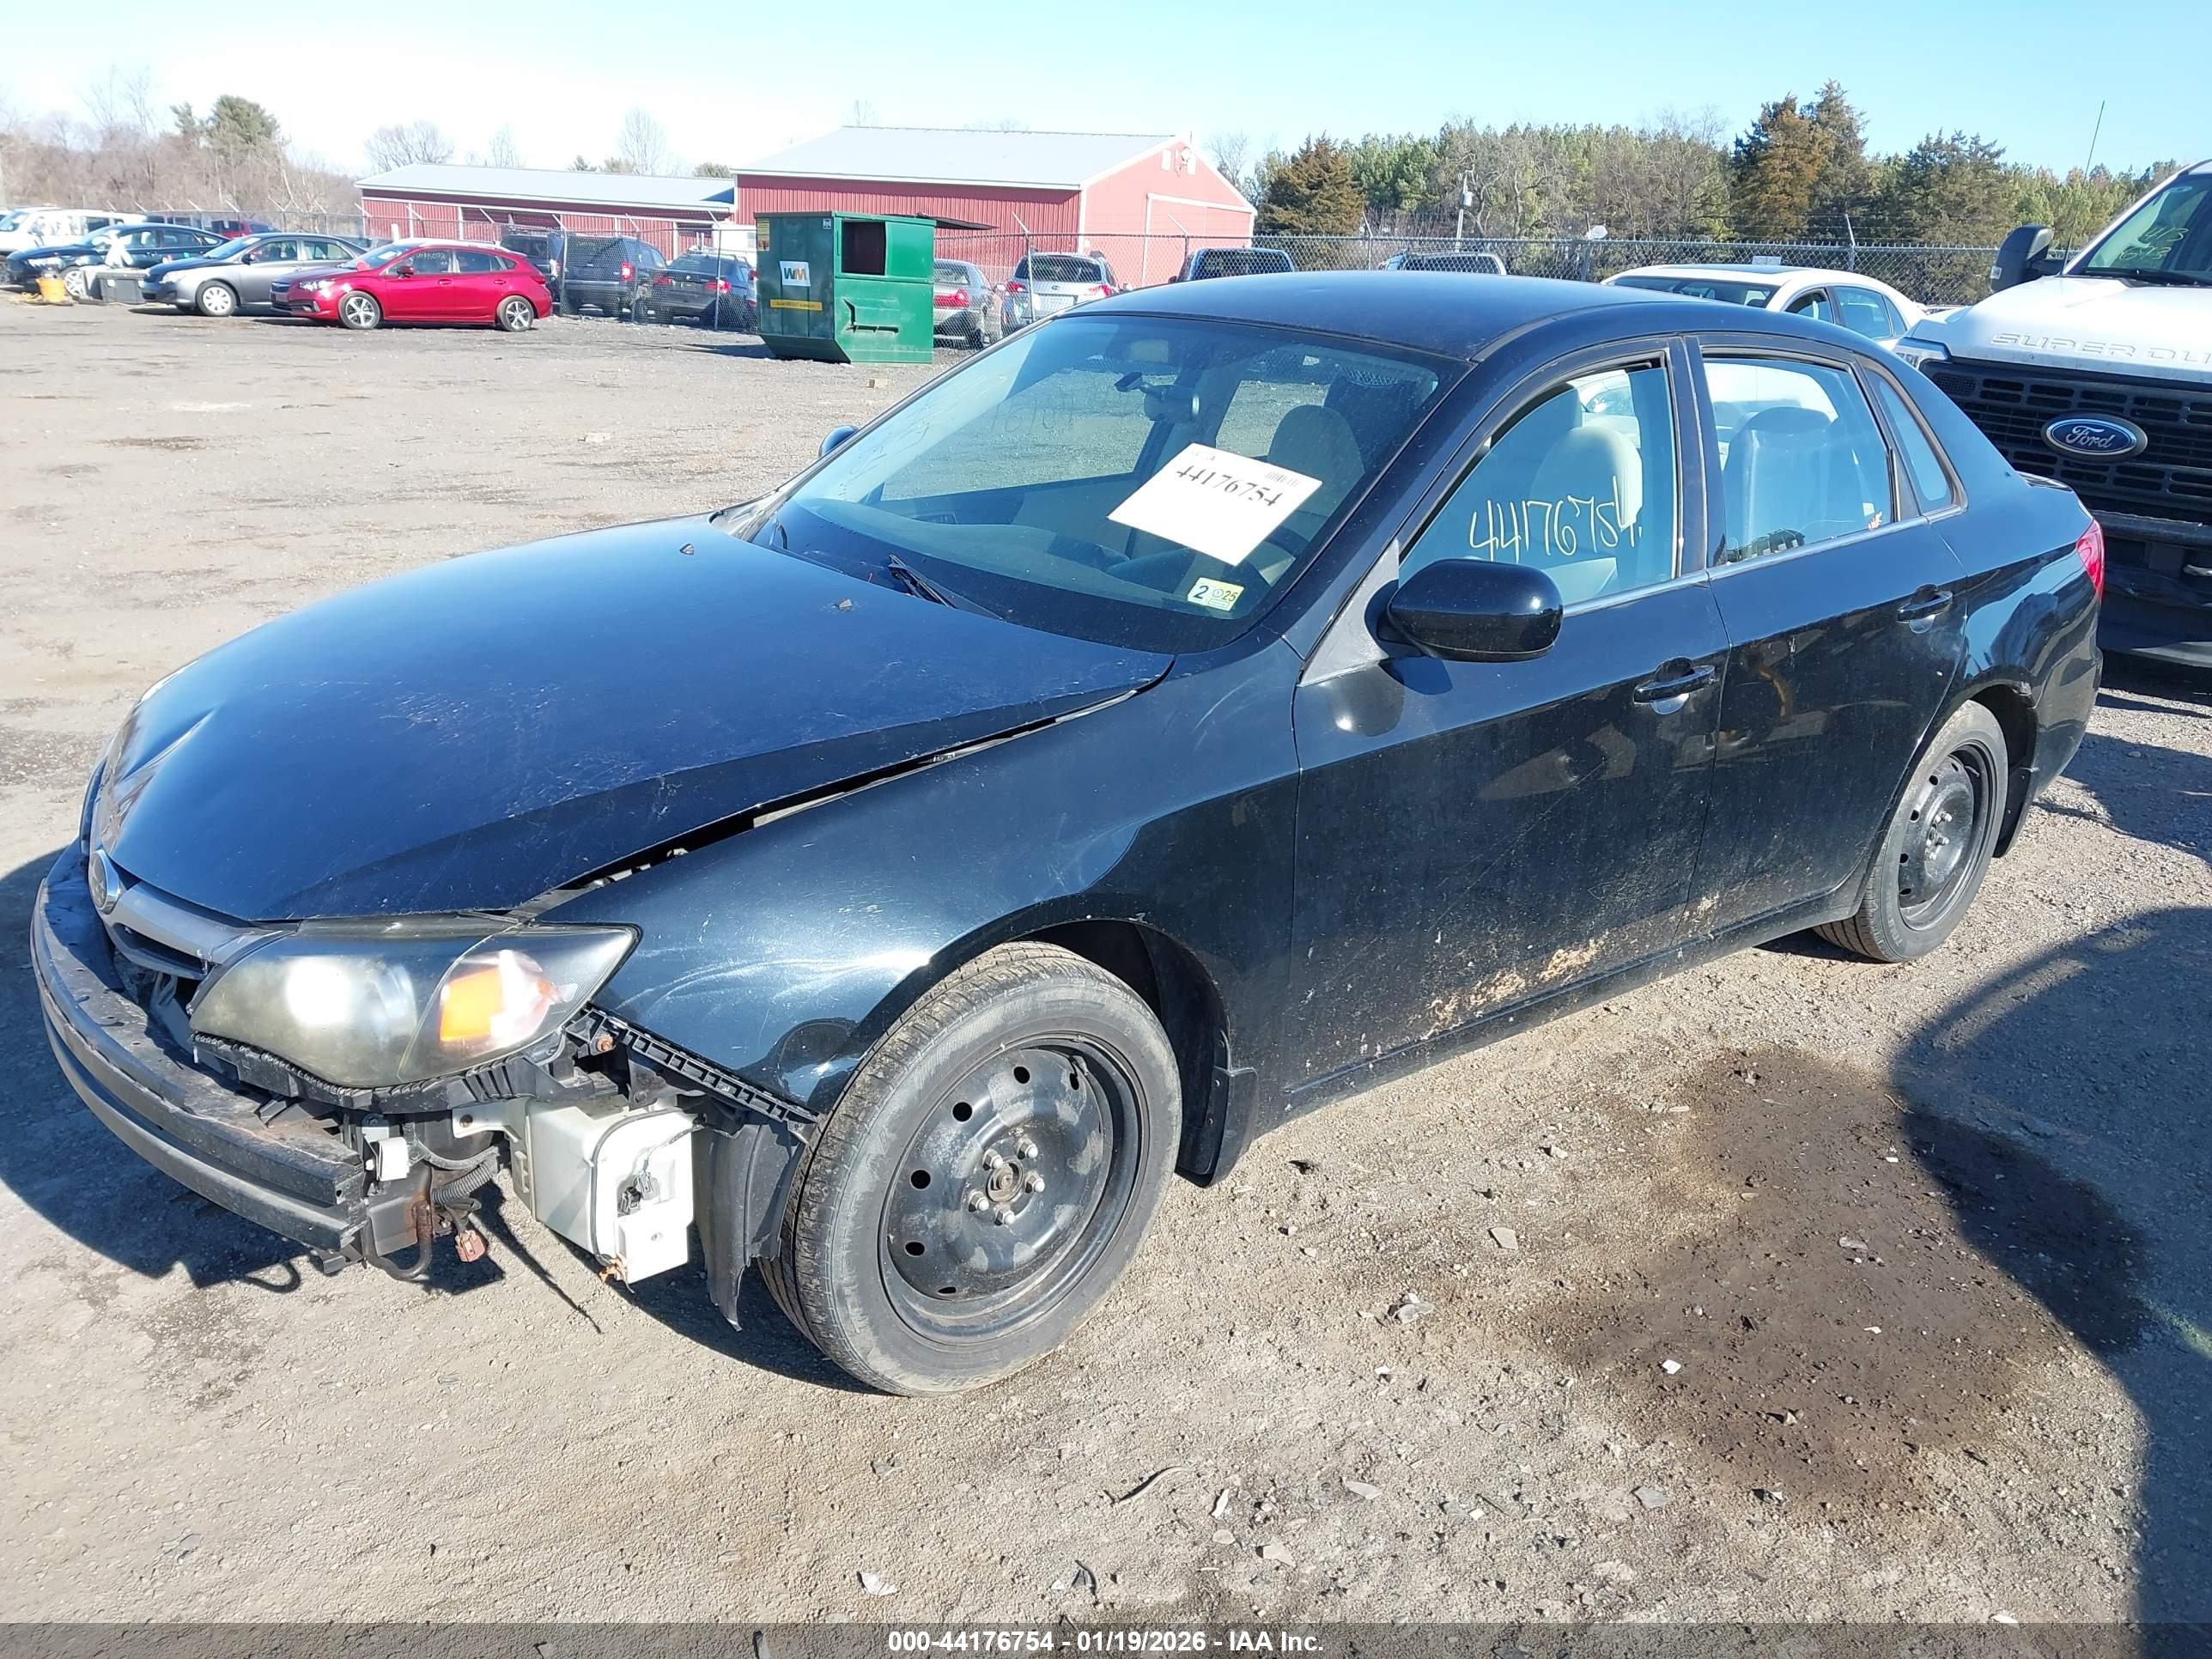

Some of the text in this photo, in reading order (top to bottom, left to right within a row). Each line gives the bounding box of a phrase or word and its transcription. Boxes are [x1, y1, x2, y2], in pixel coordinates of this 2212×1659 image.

[783, 267, 807, 280] WM
[1990, 331, 2136, 357] SUPER
[2065, 424, 2117, 448] Ford
[1176, 465, 1284, 507] 44176754
[1469, 475, 1640, 562] 44176754
[1193, 585, 1209, 600] 2
[1220, 590, 1239, 602] 25
